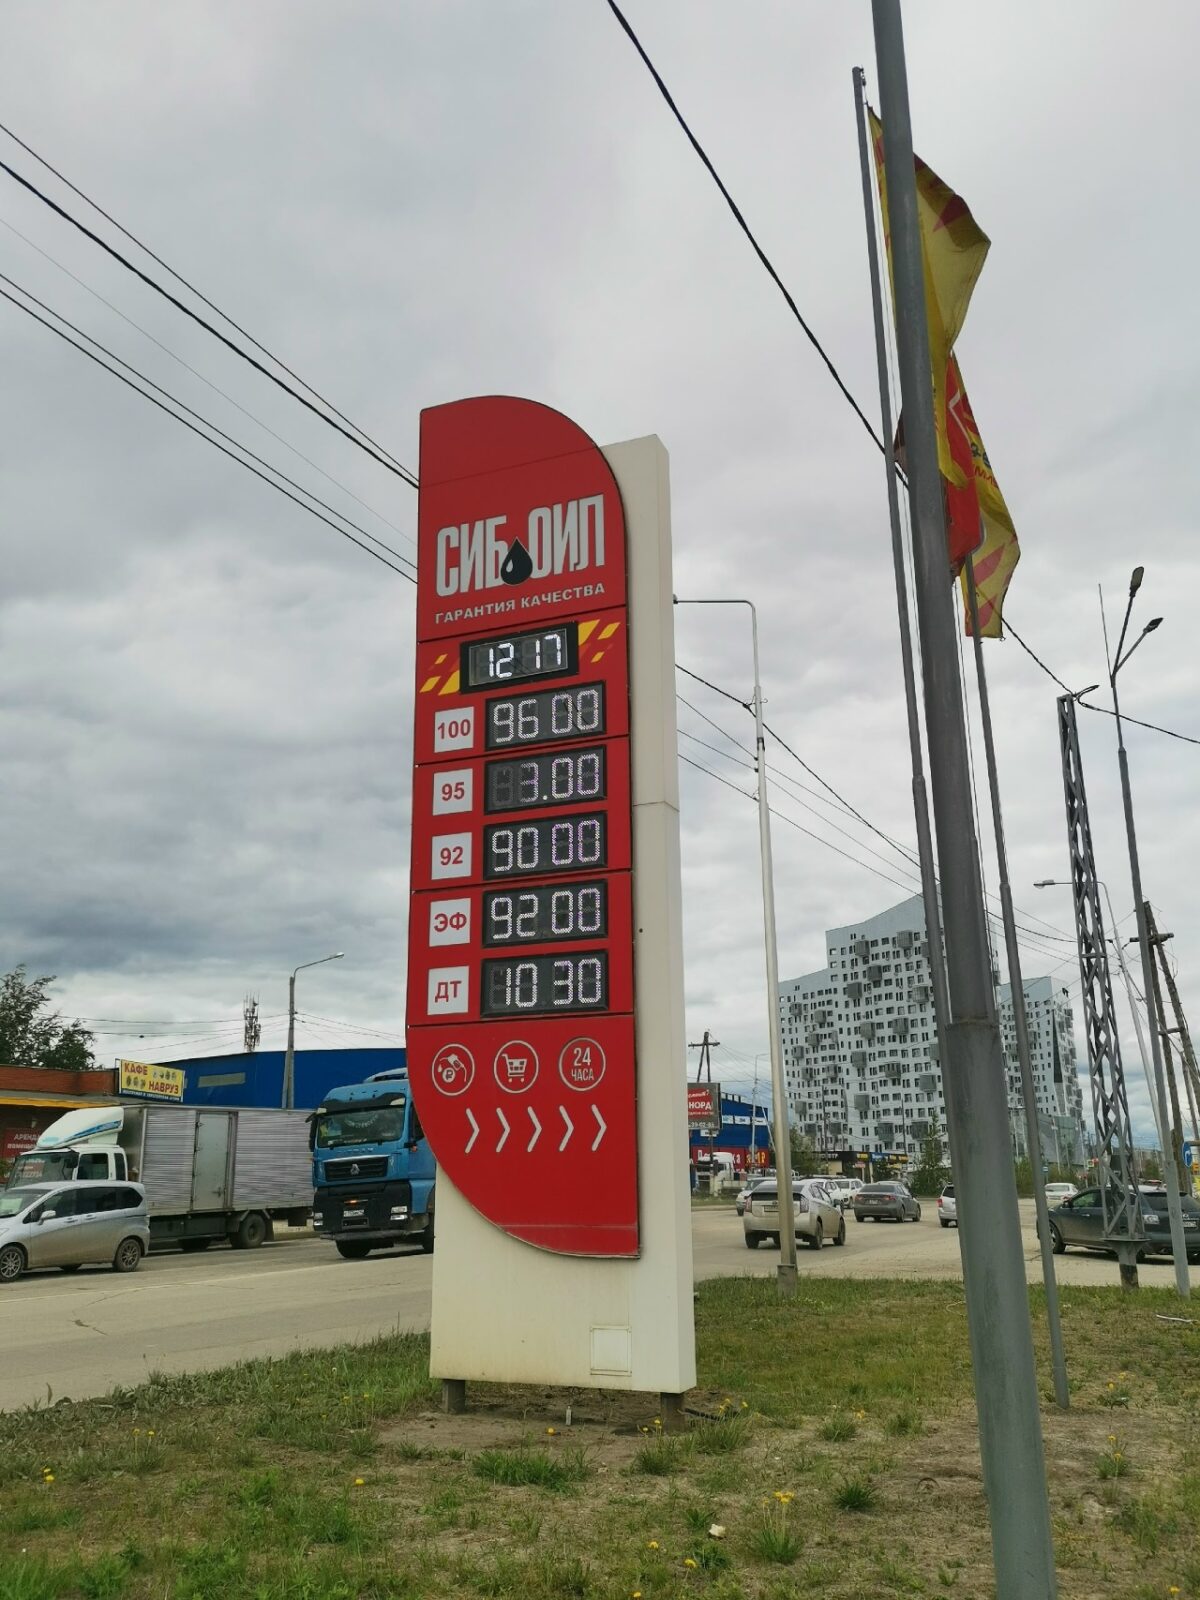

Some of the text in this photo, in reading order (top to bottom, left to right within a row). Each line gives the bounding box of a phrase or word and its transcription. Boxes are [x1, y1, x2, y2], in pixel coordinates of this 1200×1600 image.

[435, 582, 605, 624] ГАРАНТИЯ КАЧЕСТВА
[437, 719, 471, 740] 100
[441, 781, 465, 801] 95
[440, 846, 464, 866] 92
[434, 911, 467, 932] ЭФ
[434, 980, 462, 1003] ДТ
[573, 1047, 592, 1066] 24
[124, 1063, 148, 1076] КАФЕ
[571, 1067, 594, 1082] ЧАСА
[148, 1081, 179, 1095] НАВРУЗ
